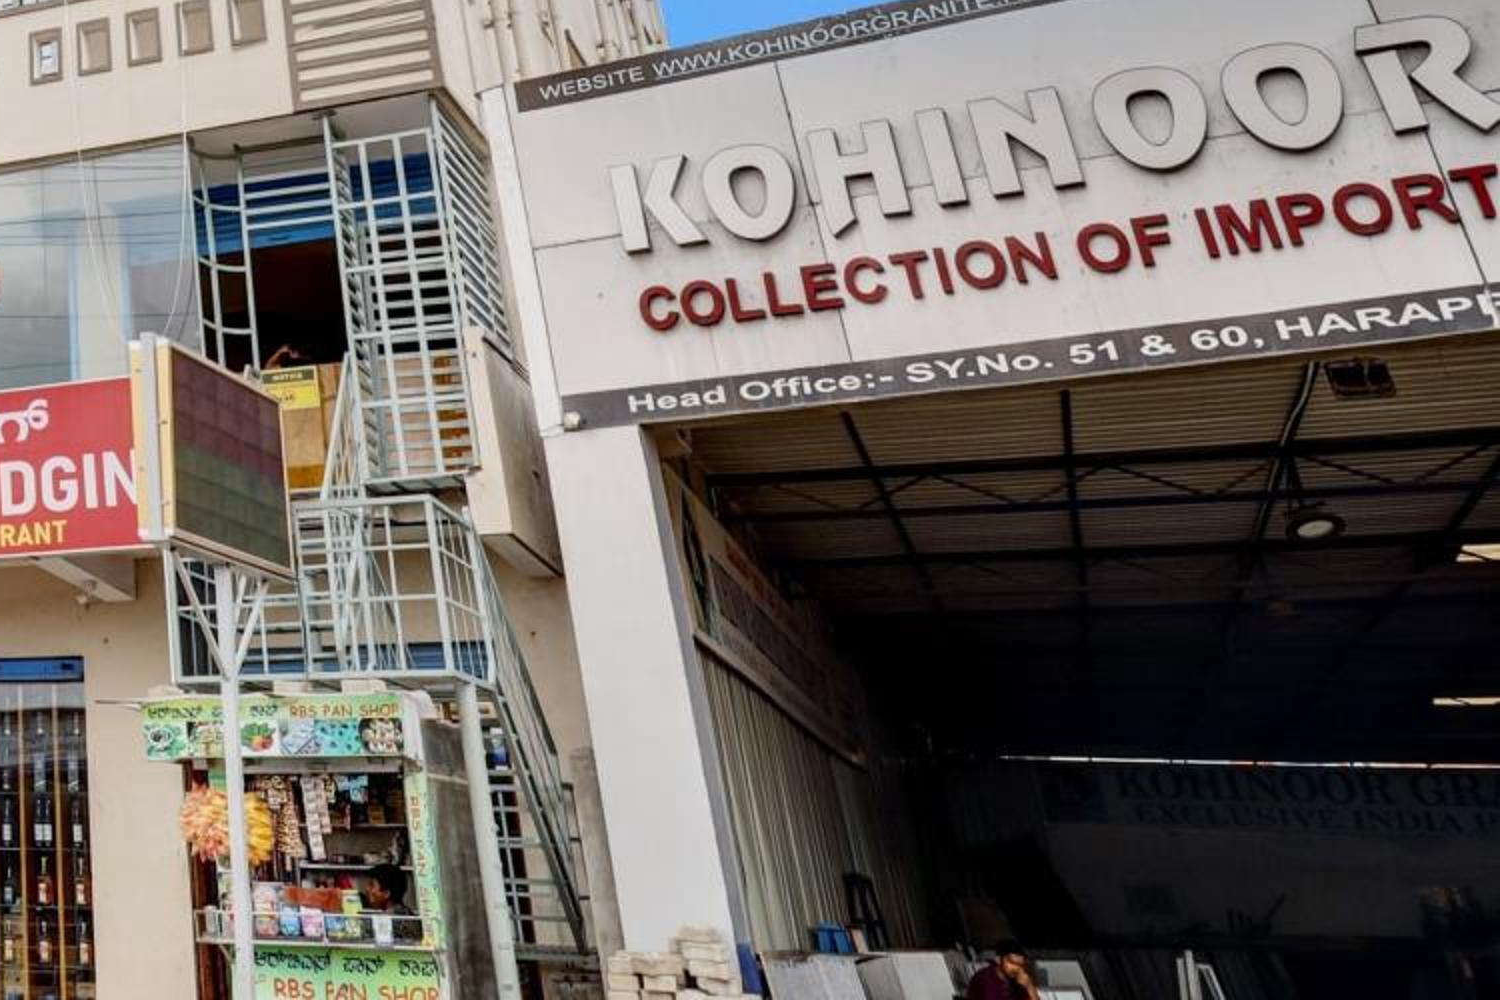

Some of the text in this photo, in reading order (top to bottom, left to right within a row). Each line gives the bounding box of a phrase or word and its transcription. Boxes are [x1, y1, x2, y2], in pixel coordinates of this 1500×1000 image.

[539, 65, 645, 101] WEBSITE
[608, 14, 1500, 257] KOHINOOR
[638, 230, 1058, 332] COLLECTION
[1076, 213, 1172, 274] OF
[627, 385, 727, 414] Head
[739, 369, 894, 402] Office:-
[905, 351, 1054, 383] SY.No.
[1069, 340, 1119, 366] 51
[1140, 334, 1176, 358] &
[1190, 325, 1265, 351] 60,
[289, 702, 399, 718] RBS PAN SHOP
[273, 977, 440, 1000] RBS PAN SHOP
